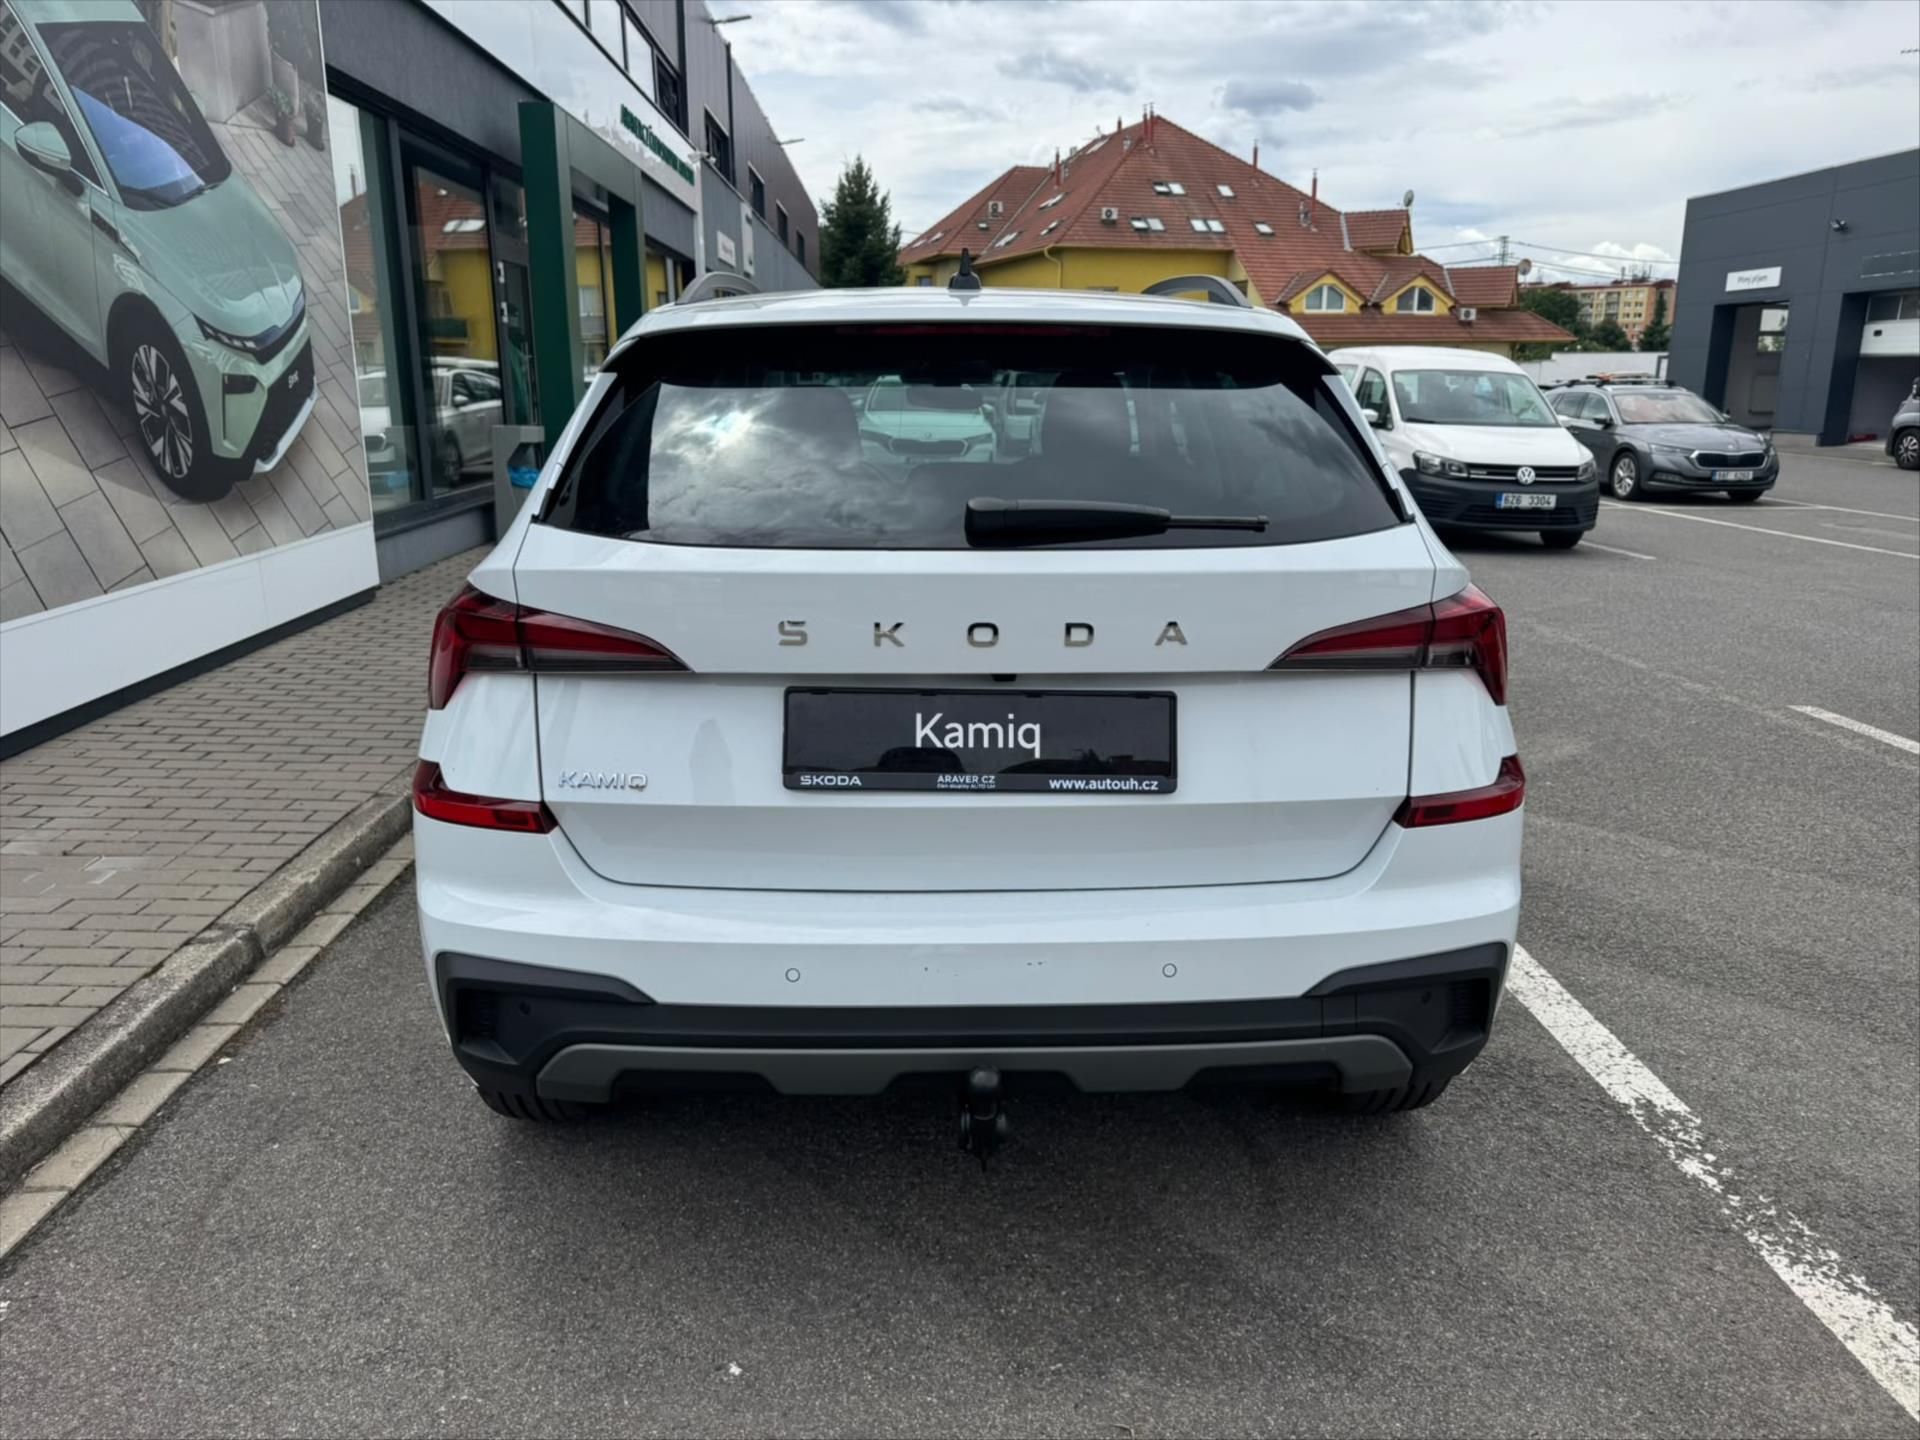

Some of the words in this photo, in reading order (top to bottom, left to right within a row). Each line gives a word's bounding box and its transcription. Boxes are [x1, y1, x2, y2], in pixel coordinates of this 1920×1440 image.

[915, 712, 1041, 759] Kamiq
[558, 771, 648, 792] KAMIQ
[937, 775, 979, 783] ARAVER
[1049, 778, 1159, 791] www.autouh.cz
